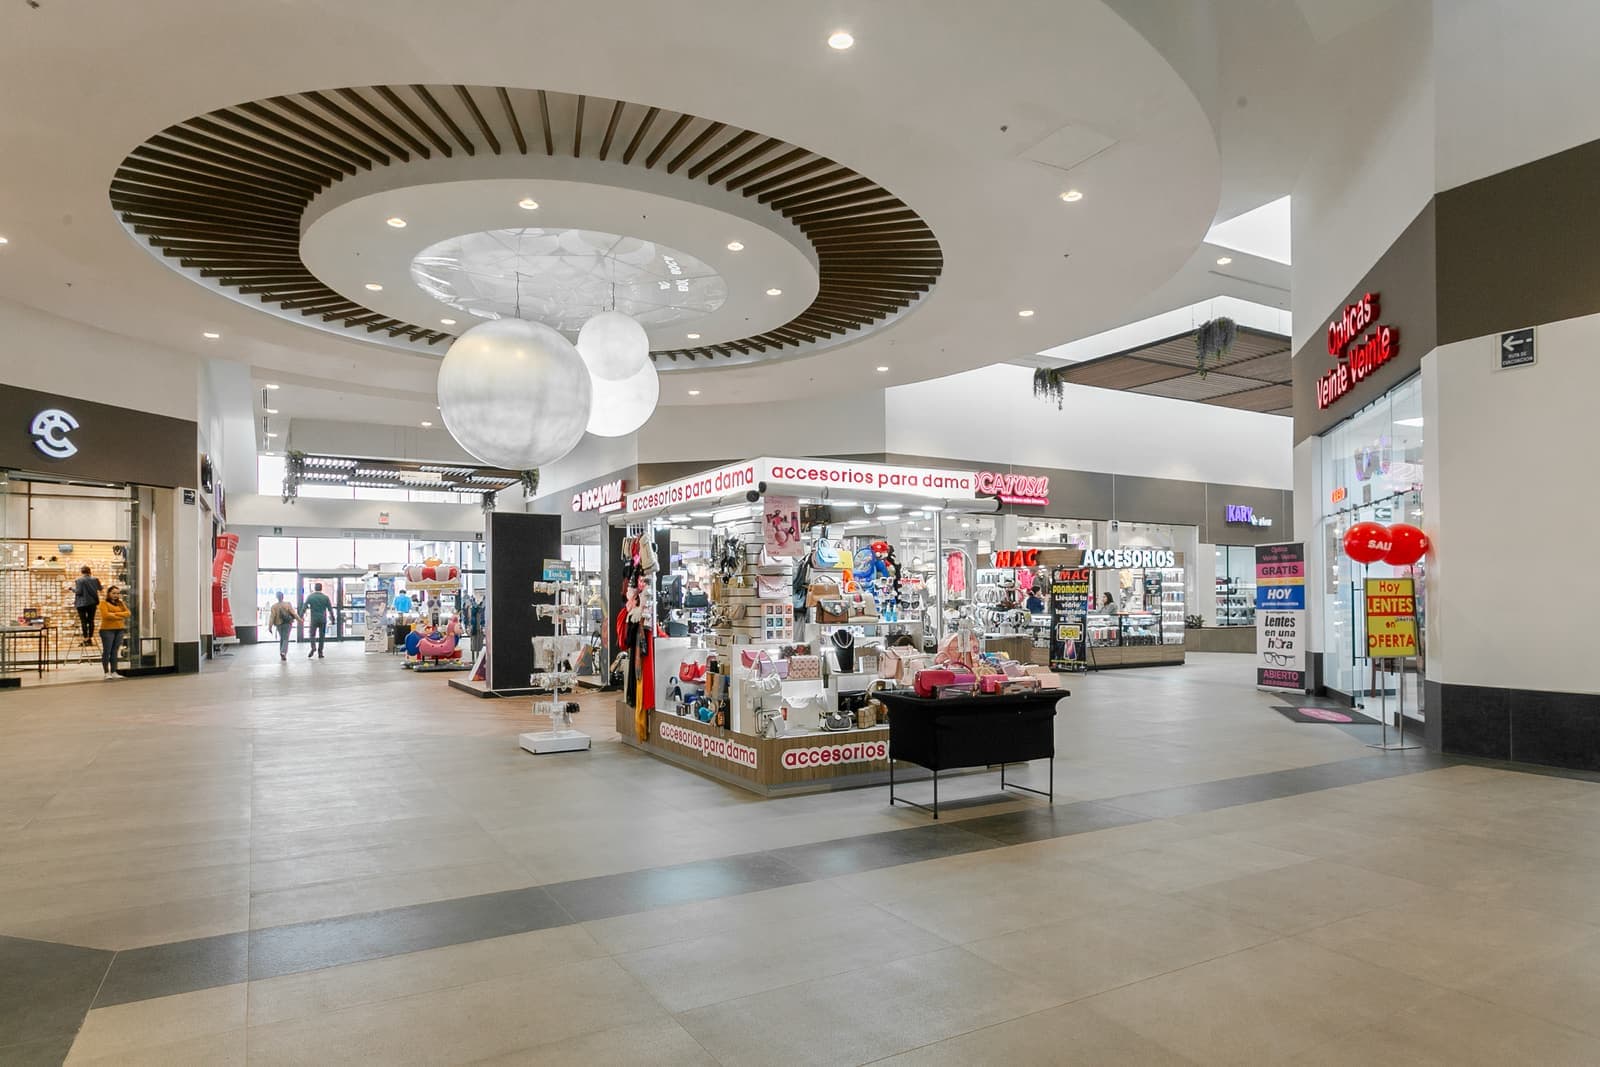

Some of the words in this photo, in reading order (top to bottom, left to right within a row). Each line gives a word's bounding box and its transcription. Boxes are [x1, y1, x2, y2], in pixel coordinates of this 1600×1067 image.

[1328, 293, 1371, 356] Opticas
[1317, 362, 1348, 409] Veinte
[1349, 326, 1390, 383] Veinte
[772, 464, 874, 484] accesorios
[878, 472, 918, 489] para
[922, 473, 970, 490] dama
[632, 486, 683, 512] accesorios
[685, 479, 712, 500] para
[715, 466, 754, 491] dama
[995, 549, 1039, 568] MAC
[1083, 549, 1175, 569] ACCESORIOS
[1058, 569, 1089, 580] MAC
[1261, 565, 1298, 576] GRATIS
[1267, 588, 1292, 600] HOY
[1379, 581, 1400, 594] Hoy
[1367, 597, 1413, 613] LENTES
[1265, 615, 1296, 628] Lentes
[1386, 621, 1396, 629] en
[1265, 629, 1276, 637] en
[1278, 629, 1296, 638] una
[1368, 634, 1416, 648] OFERTA
[1263, 669, 1299, 681] ABIERTO
[661, 724, 702, 748] accesorios
[704, 736, 725, 756] para
[727, 740, 756, 765] dama
[785, 743, 885, 767] accesorios
